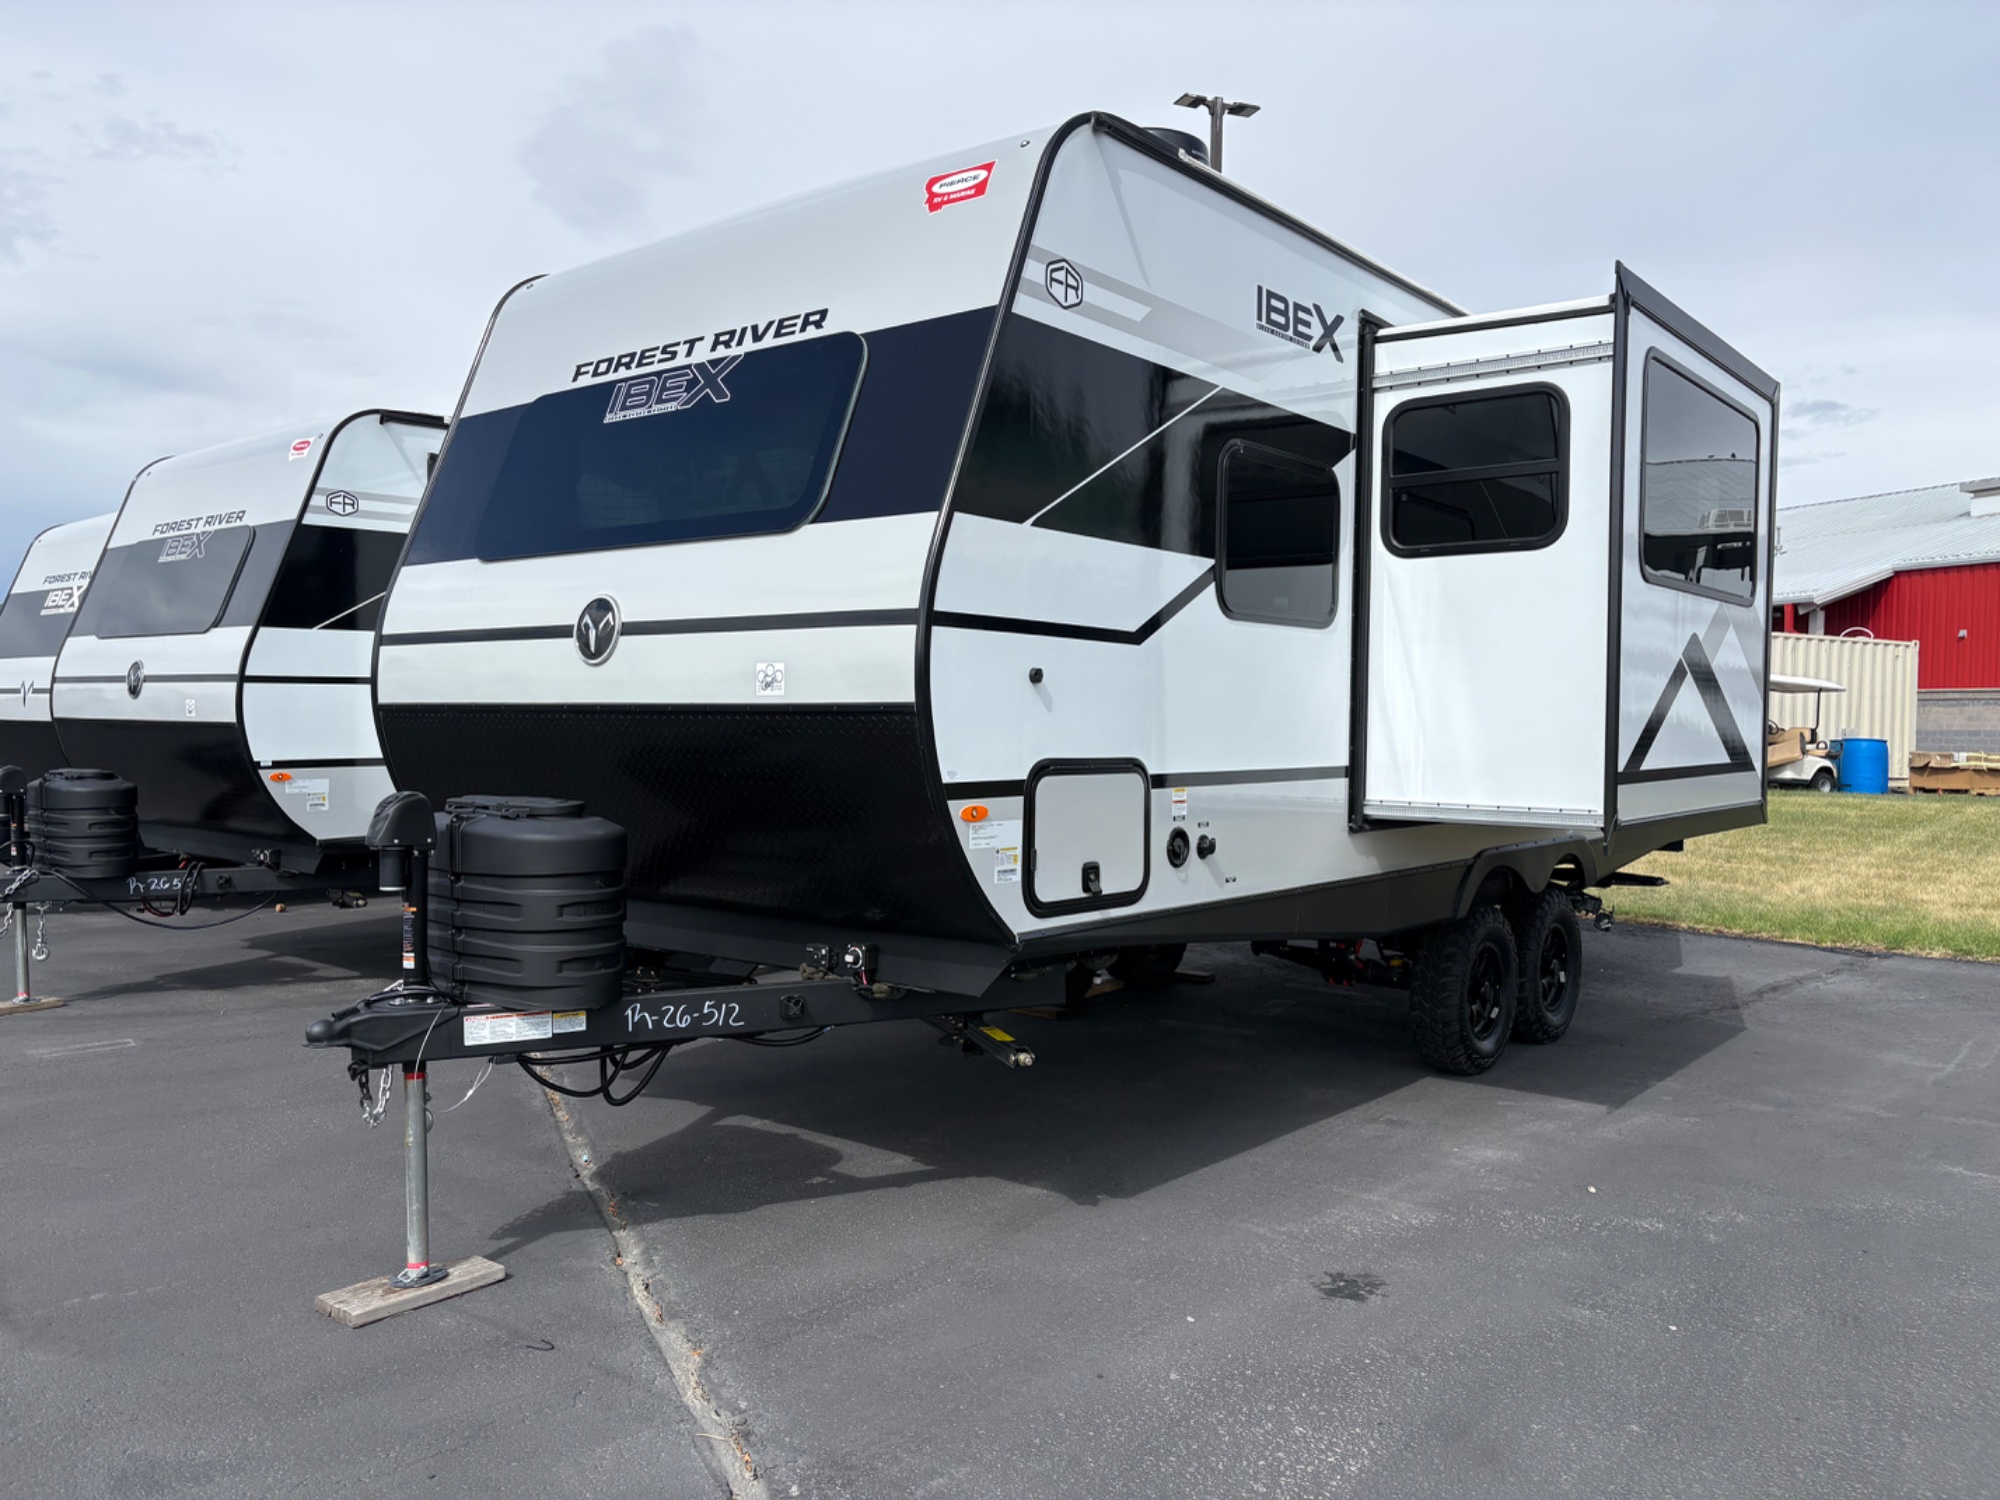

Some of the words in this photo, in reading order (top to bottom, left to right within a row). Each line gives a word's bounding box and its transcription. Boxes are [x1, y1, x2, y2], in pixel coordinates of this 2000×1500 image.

[939, 174, 980, 189] PIERCE
[1256, 283, 1345, 363] IBEX
[571, 336, 704, 383] FOREST
[709, 307, 829, 352] RIVER
[605, 353, 745, 416] IBEX
[152, 516, 204, 536] FOREST
[203, 509, 247, 527] RIVER
[160, 530, 213, 558] IBEX
[43, 572, 79, 585] FOREST
[44, 586, 87, 608] IBEX
